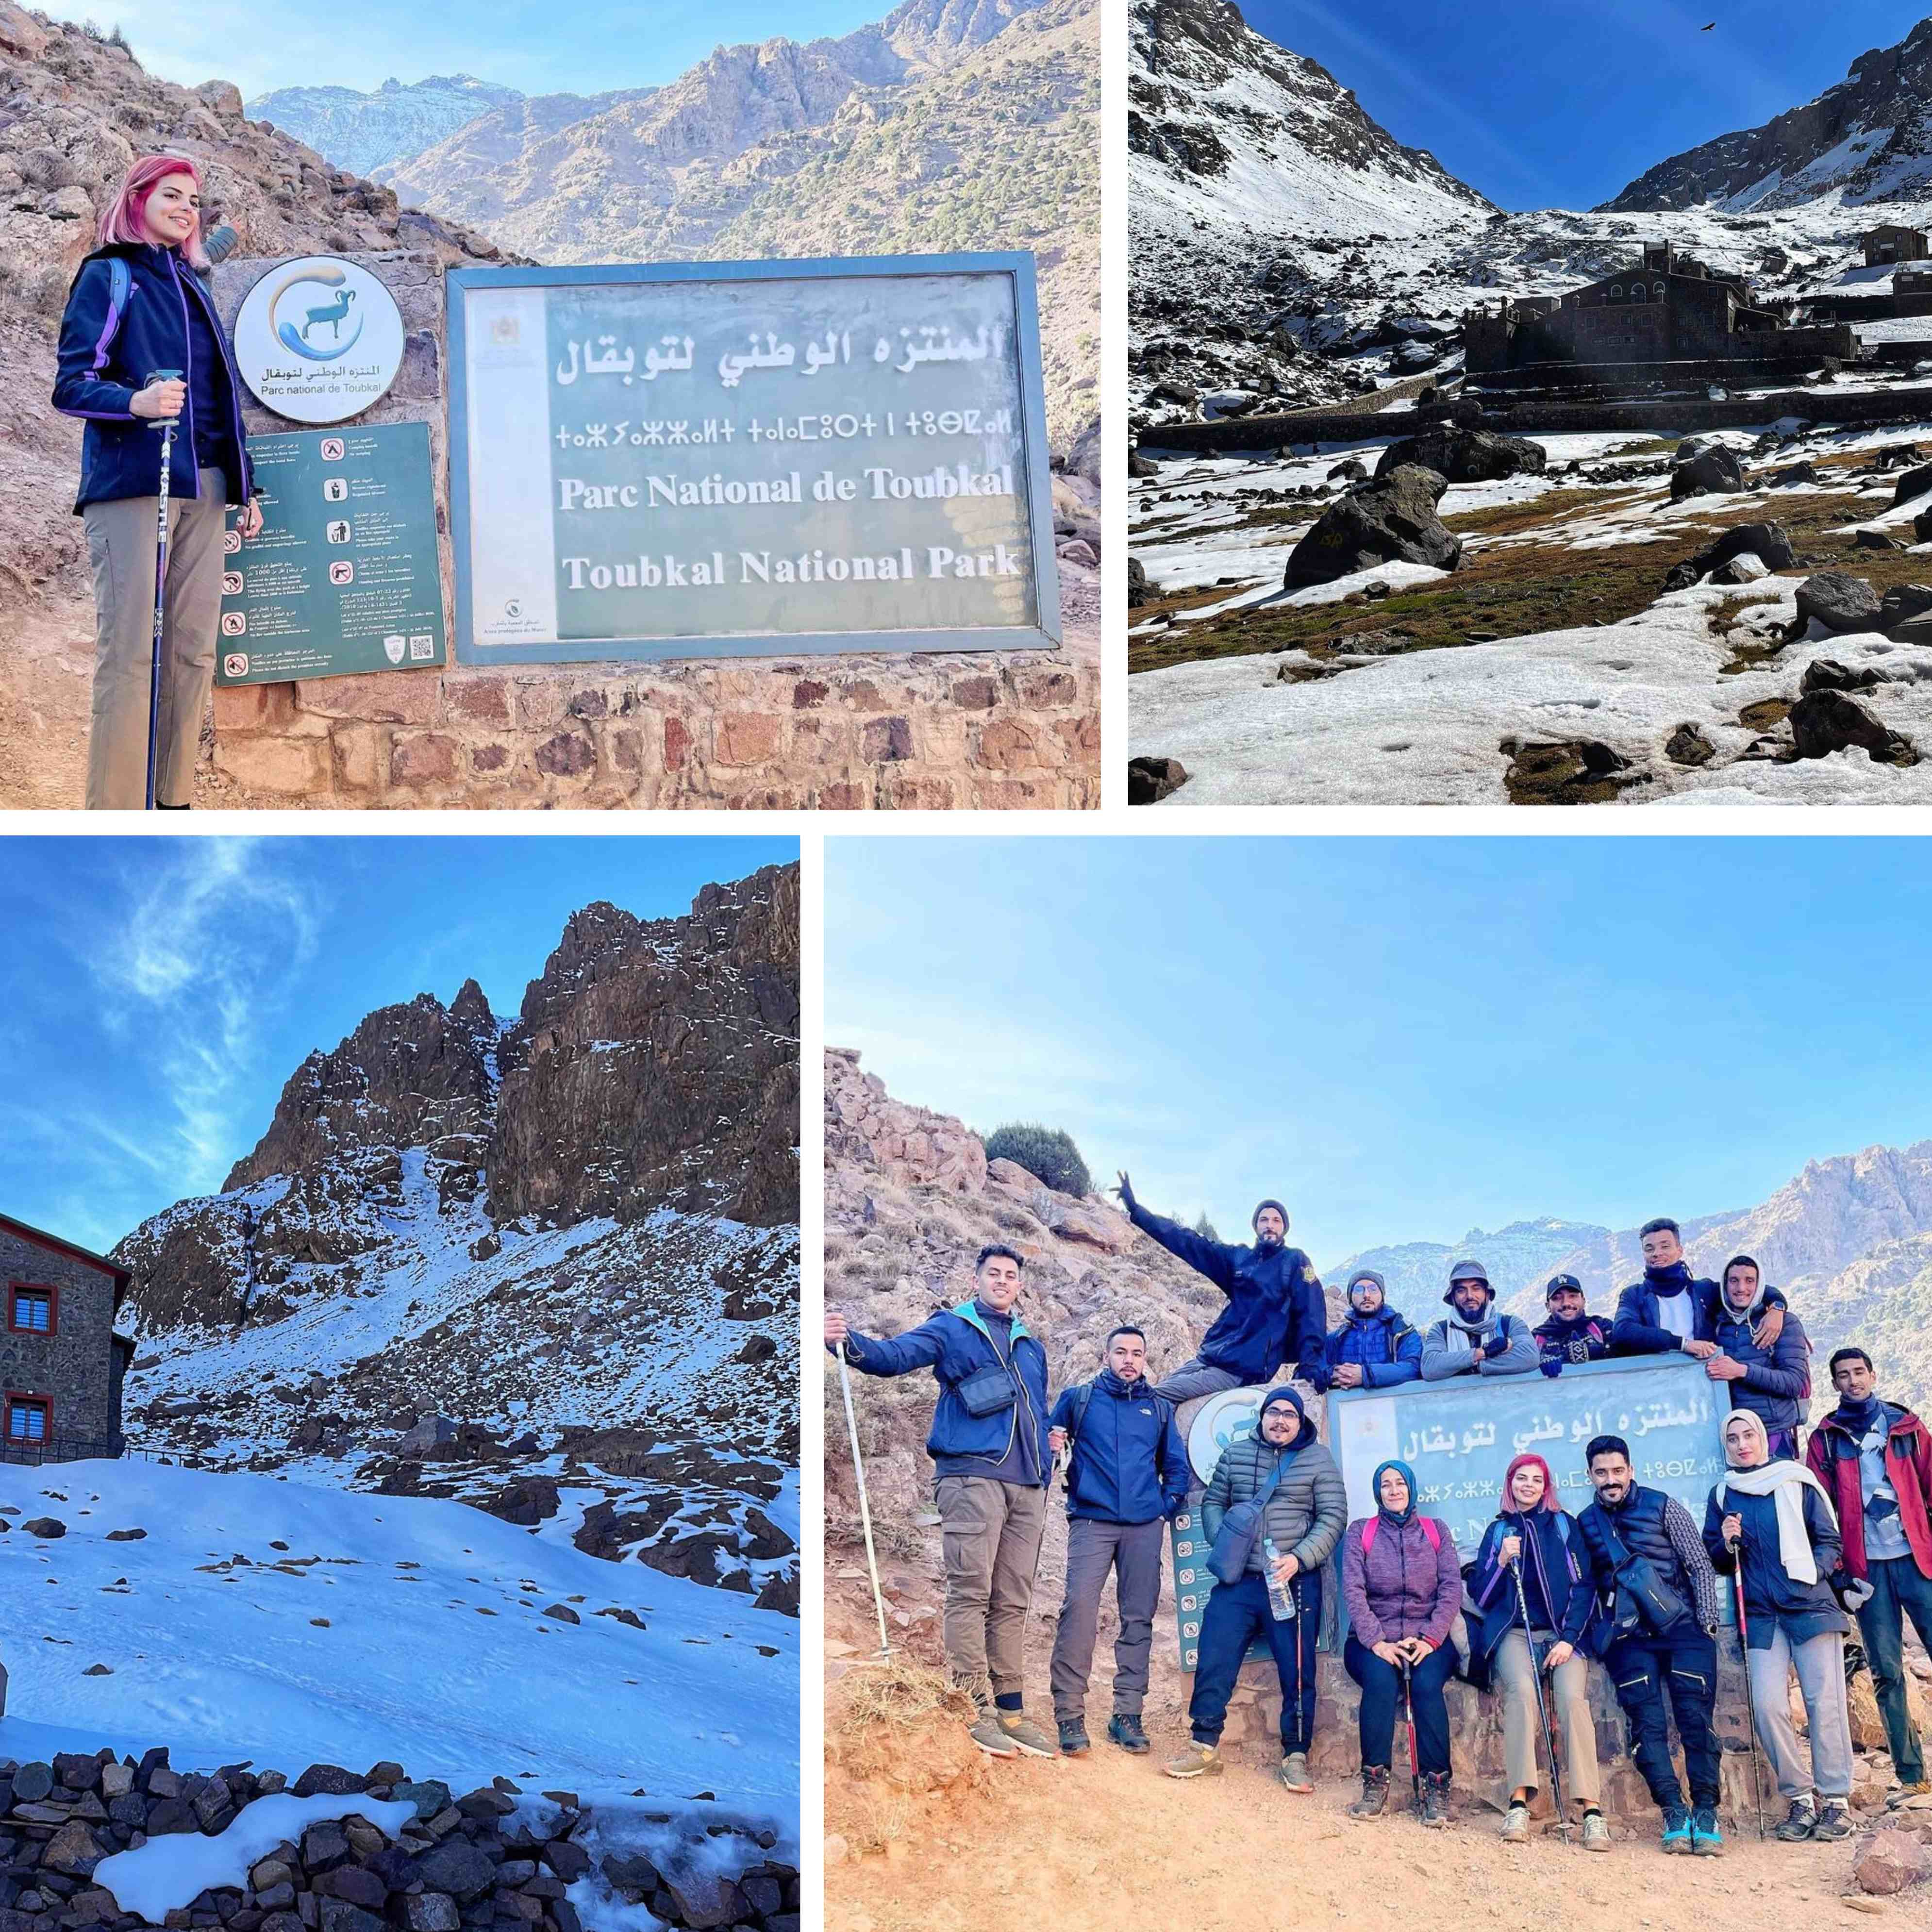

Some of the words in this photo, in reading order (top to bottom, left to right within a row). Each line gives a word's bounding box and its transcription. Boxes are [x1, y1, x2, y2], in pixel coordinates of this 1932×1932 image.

[556, 335, 695, 385] لتوبقال
[718, 331, 851, 387] الوطني
[874, 326, 1003, 372] المنتزه
[262, 367, 302, 381] لتوبقال
[262, 385, 284, 395] Parc
[287, 384, 325, 394] national
[329, 383, 340, 393] de
[343, 383, 381, 392] Toubkal
[306, 366, 345, 382] الوطني
[350, 365, 380, 378] المنتزه
[559, 478, 638, 510] Parc
[645, 471, 802, 507] National
[814, 471, 856, 501] de
[863, 463, 1015, 500] Toubkal
[562, 551, 726, 589] Toubkal
[739, 548, 913, 583] National
[927, 544, 1021, 579] Park
[1513, 1410, 1601, 1456] الوطني
[1618, 1399, 1708, 1436] المنتزه
[1403, 1421, 1496, 1462] لتوبقال
